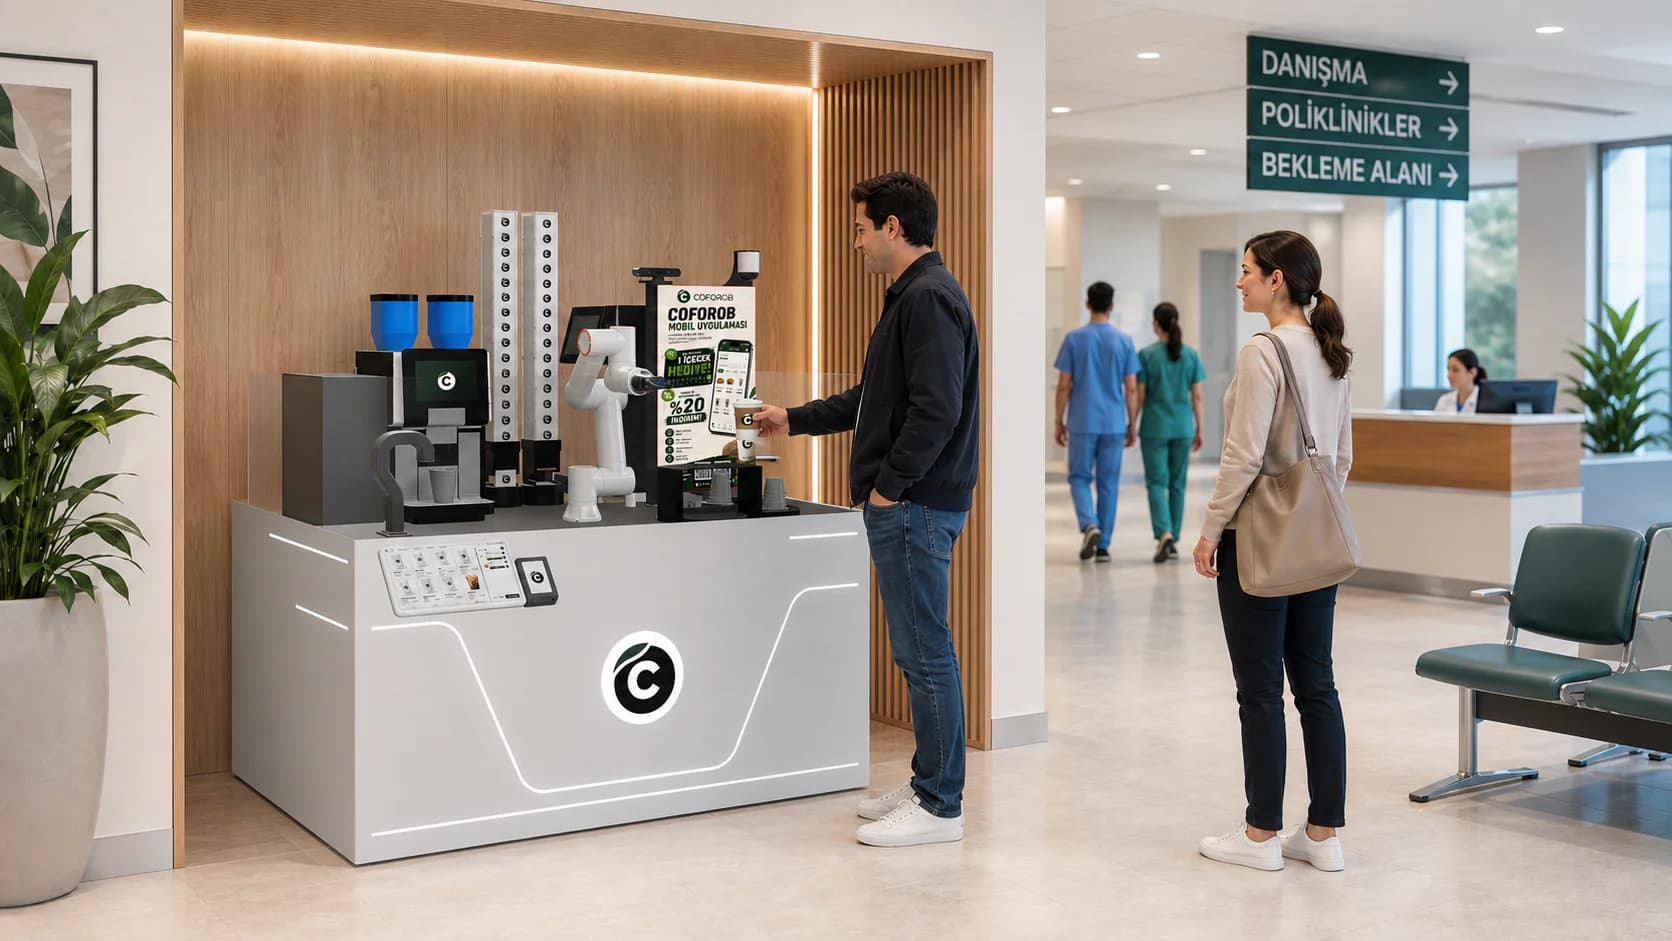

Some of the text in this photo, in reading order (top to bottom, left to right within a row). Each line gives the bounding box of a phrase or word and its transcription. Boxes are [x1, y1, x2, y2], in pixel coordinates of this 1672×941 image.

[1262, 49, 1368, 88] DANIŞMA
[1262, 99, 1421, 139] POLİKLİNİKLER
[1262, 152, 1432, 186] BEKLEME ALANI
[668, 306, 736, 321] COFOROB
[698, 320, 747, 330] UYGULAMASI
[442, 376, 451, 386] C
[670, 397, 704, 414] %20
[628, 660, 660, 700] C
